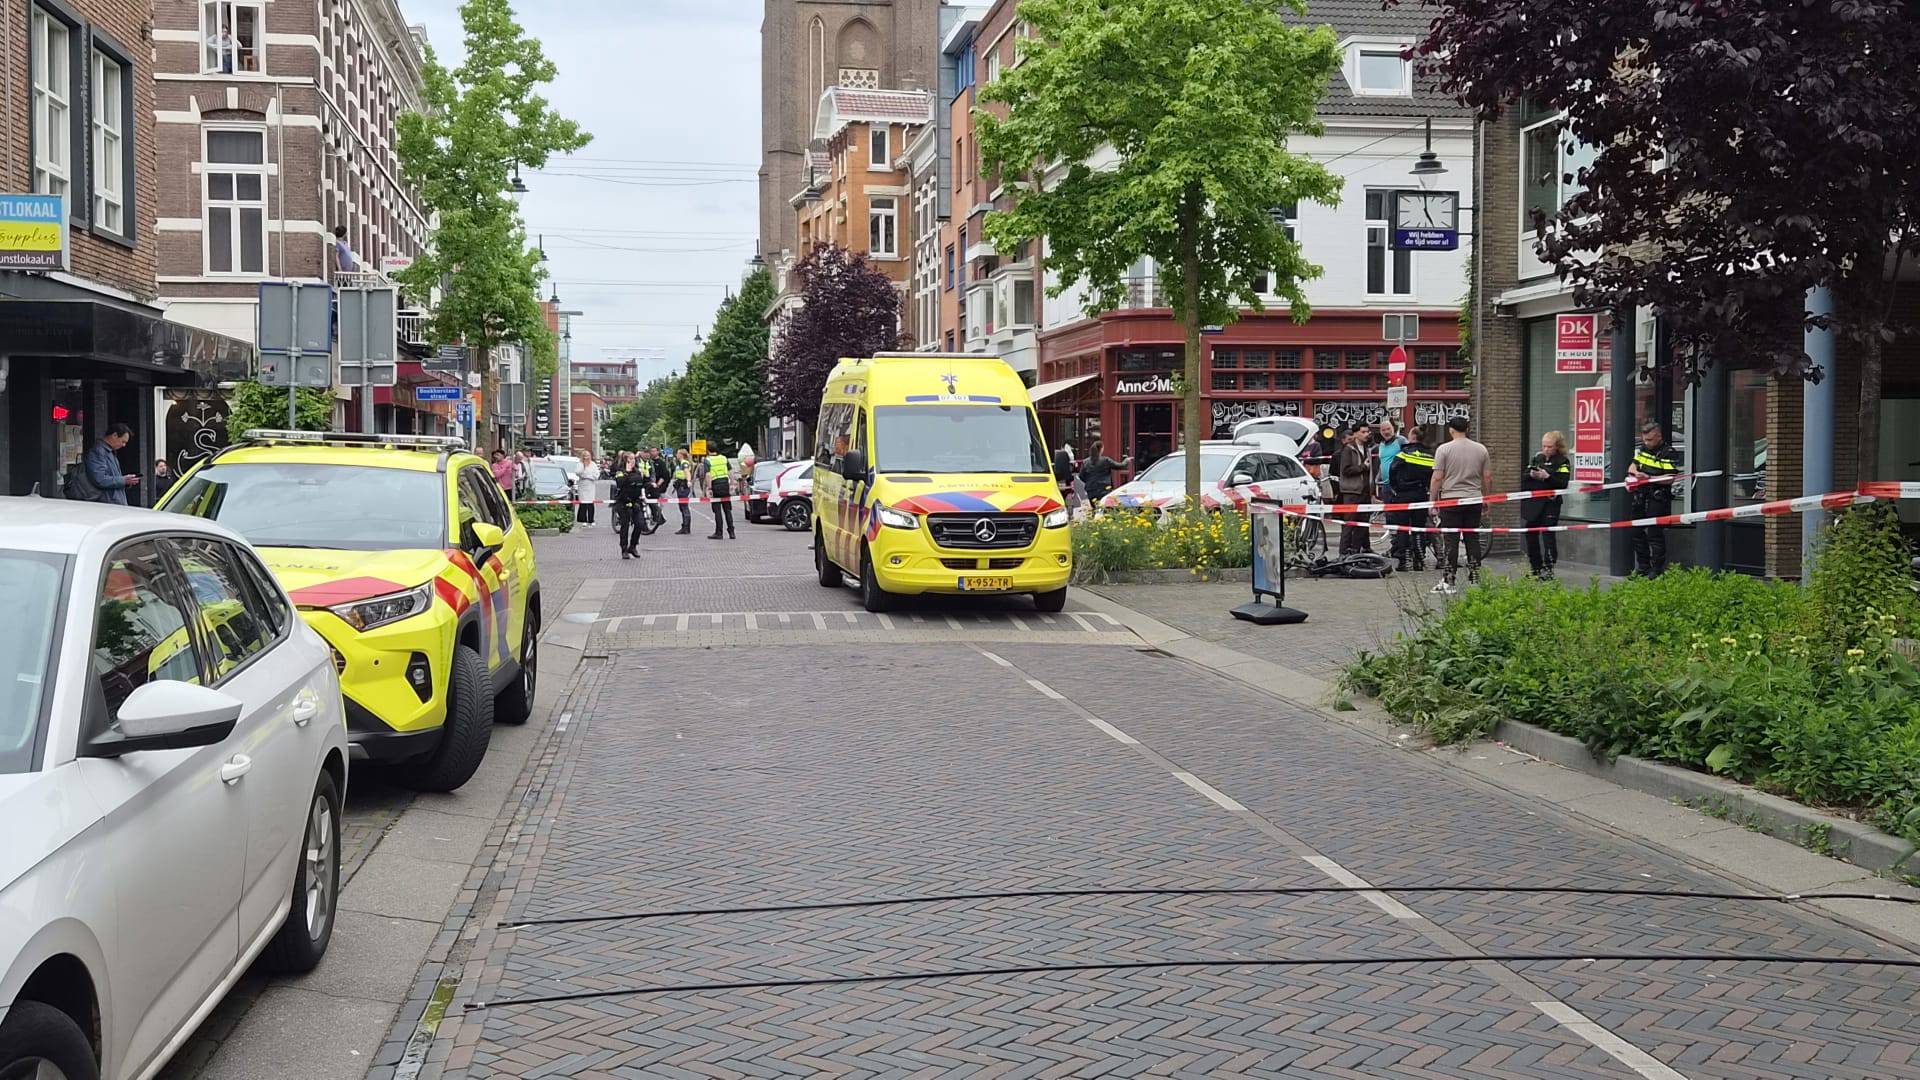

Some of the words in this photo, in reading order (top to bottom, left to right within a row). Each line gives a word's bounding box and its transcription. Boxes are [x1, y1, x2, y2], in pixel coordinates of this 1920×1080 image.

[0, 201, 57, 218] TLOKAAL
[0, 227, 56, 248] supplies
[0, 253, 55, 265] unstlokaal.nl
[1560, 321, 1590, 335] DK
[1578, 399, 1601, 424] DK
[1575, 455, 1583, 466] TE
[1584, 455, 1603, 466] HUUR
[268, 563, 339, 571] ANCE
[966, 578, 1009, 587] X-952-TR
